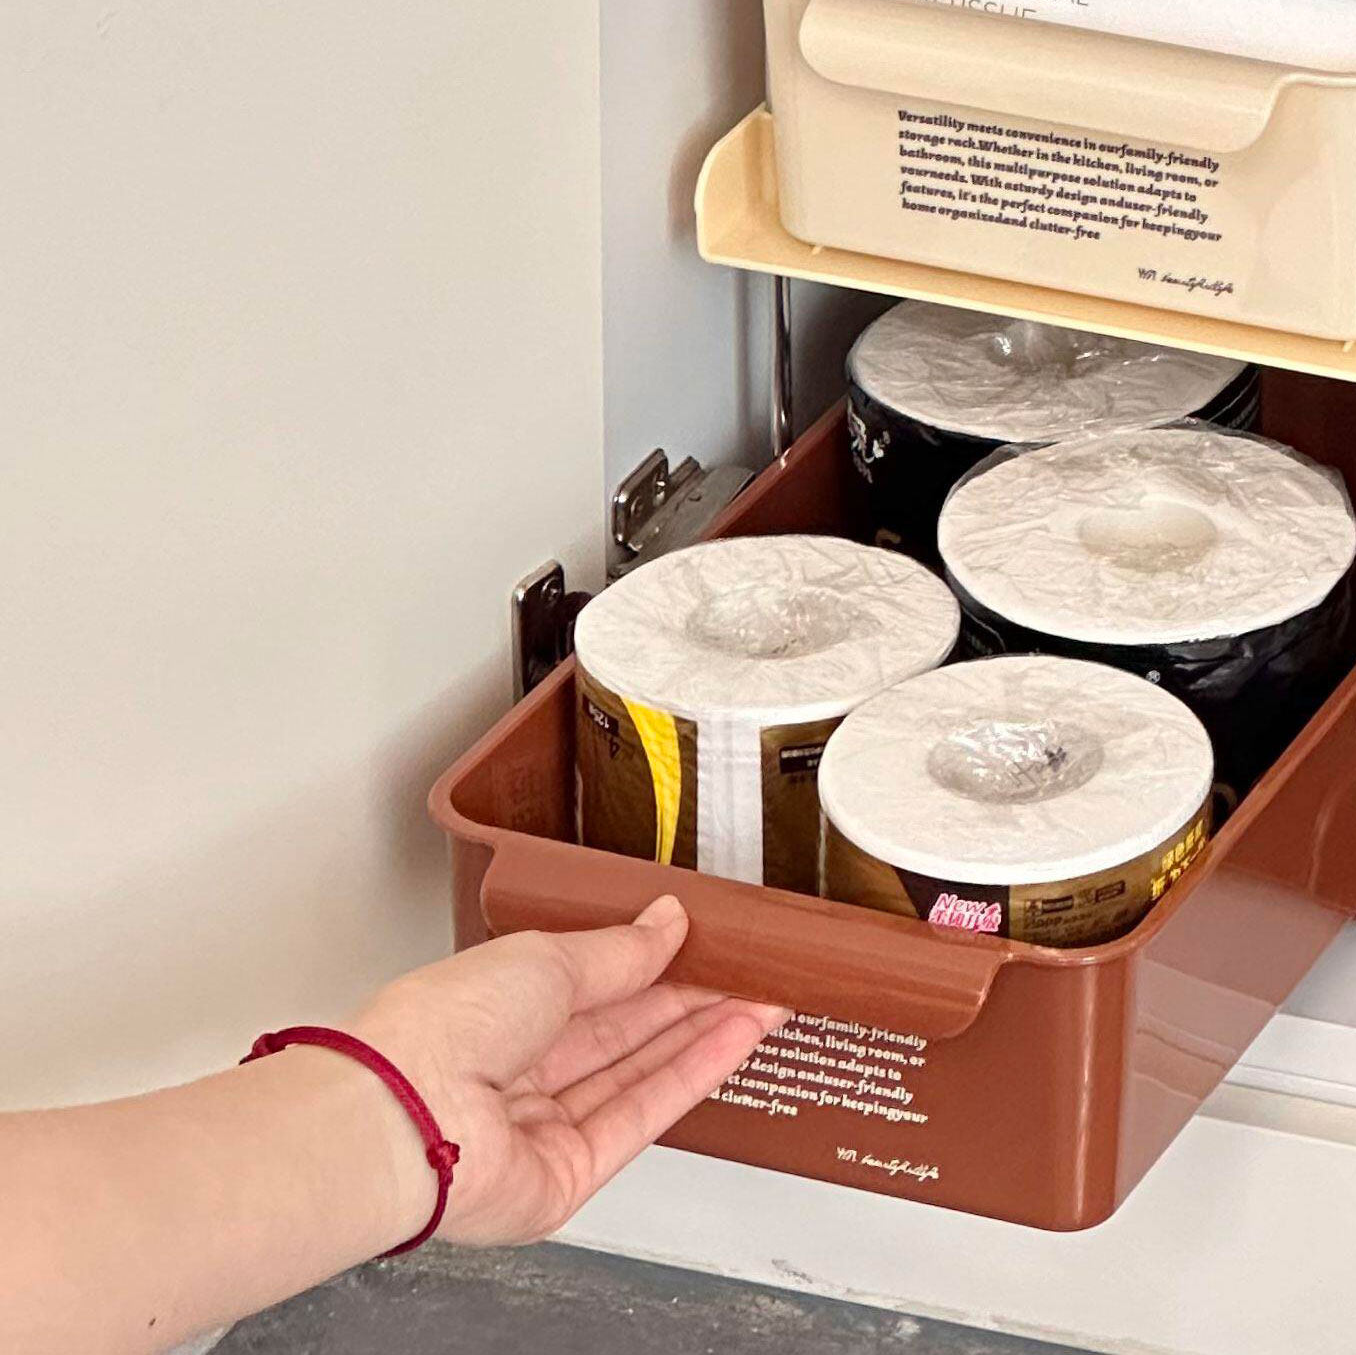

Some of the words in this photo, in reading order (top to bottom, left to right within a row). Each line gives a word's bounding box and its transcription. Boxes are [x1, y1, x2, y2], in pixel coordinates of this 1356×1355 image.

[780, 1046, 836, 1067] solution
[837, 1058, 886, 1078] adapts
[888, 1068, 902, 1081] to
[825, 1035, 866, 1059] living
[909, 1056, 926, 1067] or
[750, 1058, 796, 1079] design
[741, 1078, 818, 1101] companion
[816, 1090, 841, 1106] for
